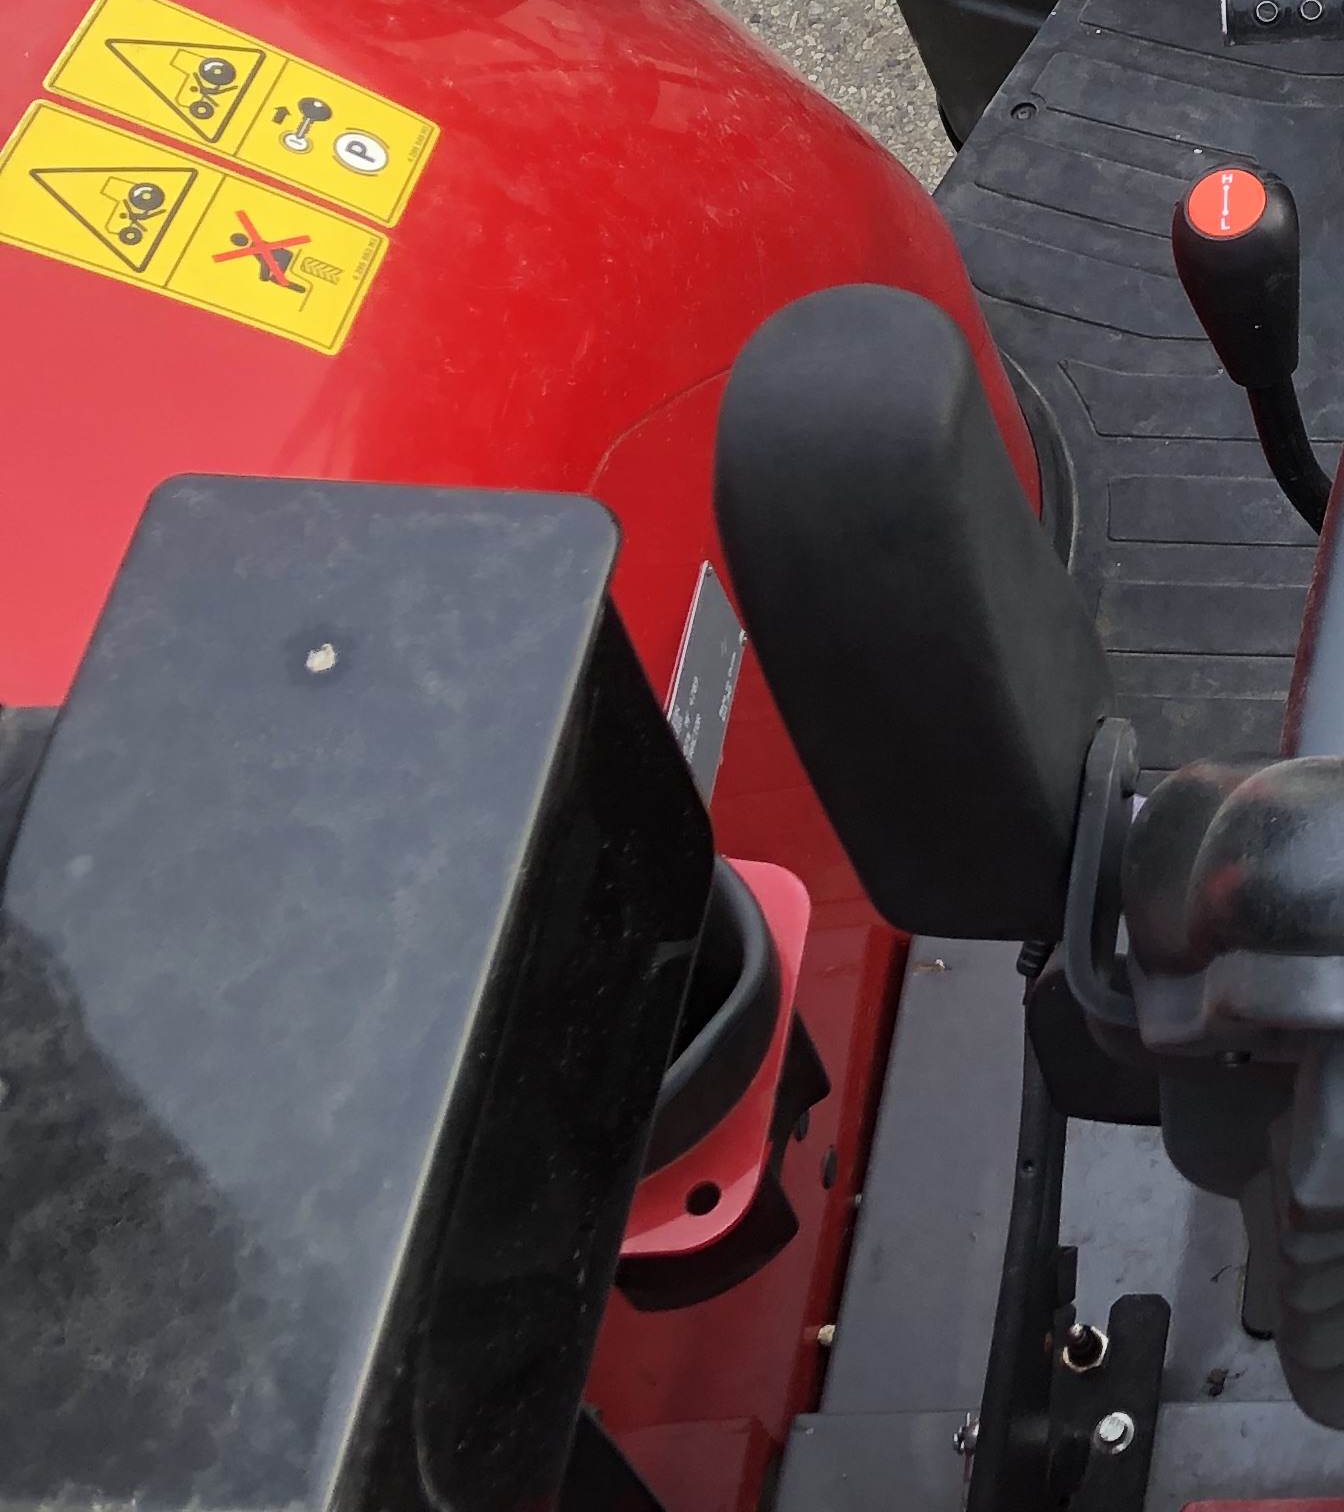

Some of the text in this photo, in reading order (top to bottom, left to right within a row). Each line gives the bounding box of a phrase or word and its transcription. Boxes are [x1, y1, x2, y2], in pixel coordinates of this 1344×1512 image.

[345, 140, 376, 163] P
[1222, 173, 1233, 184] H
[1221, 217, 1231, 230] L
